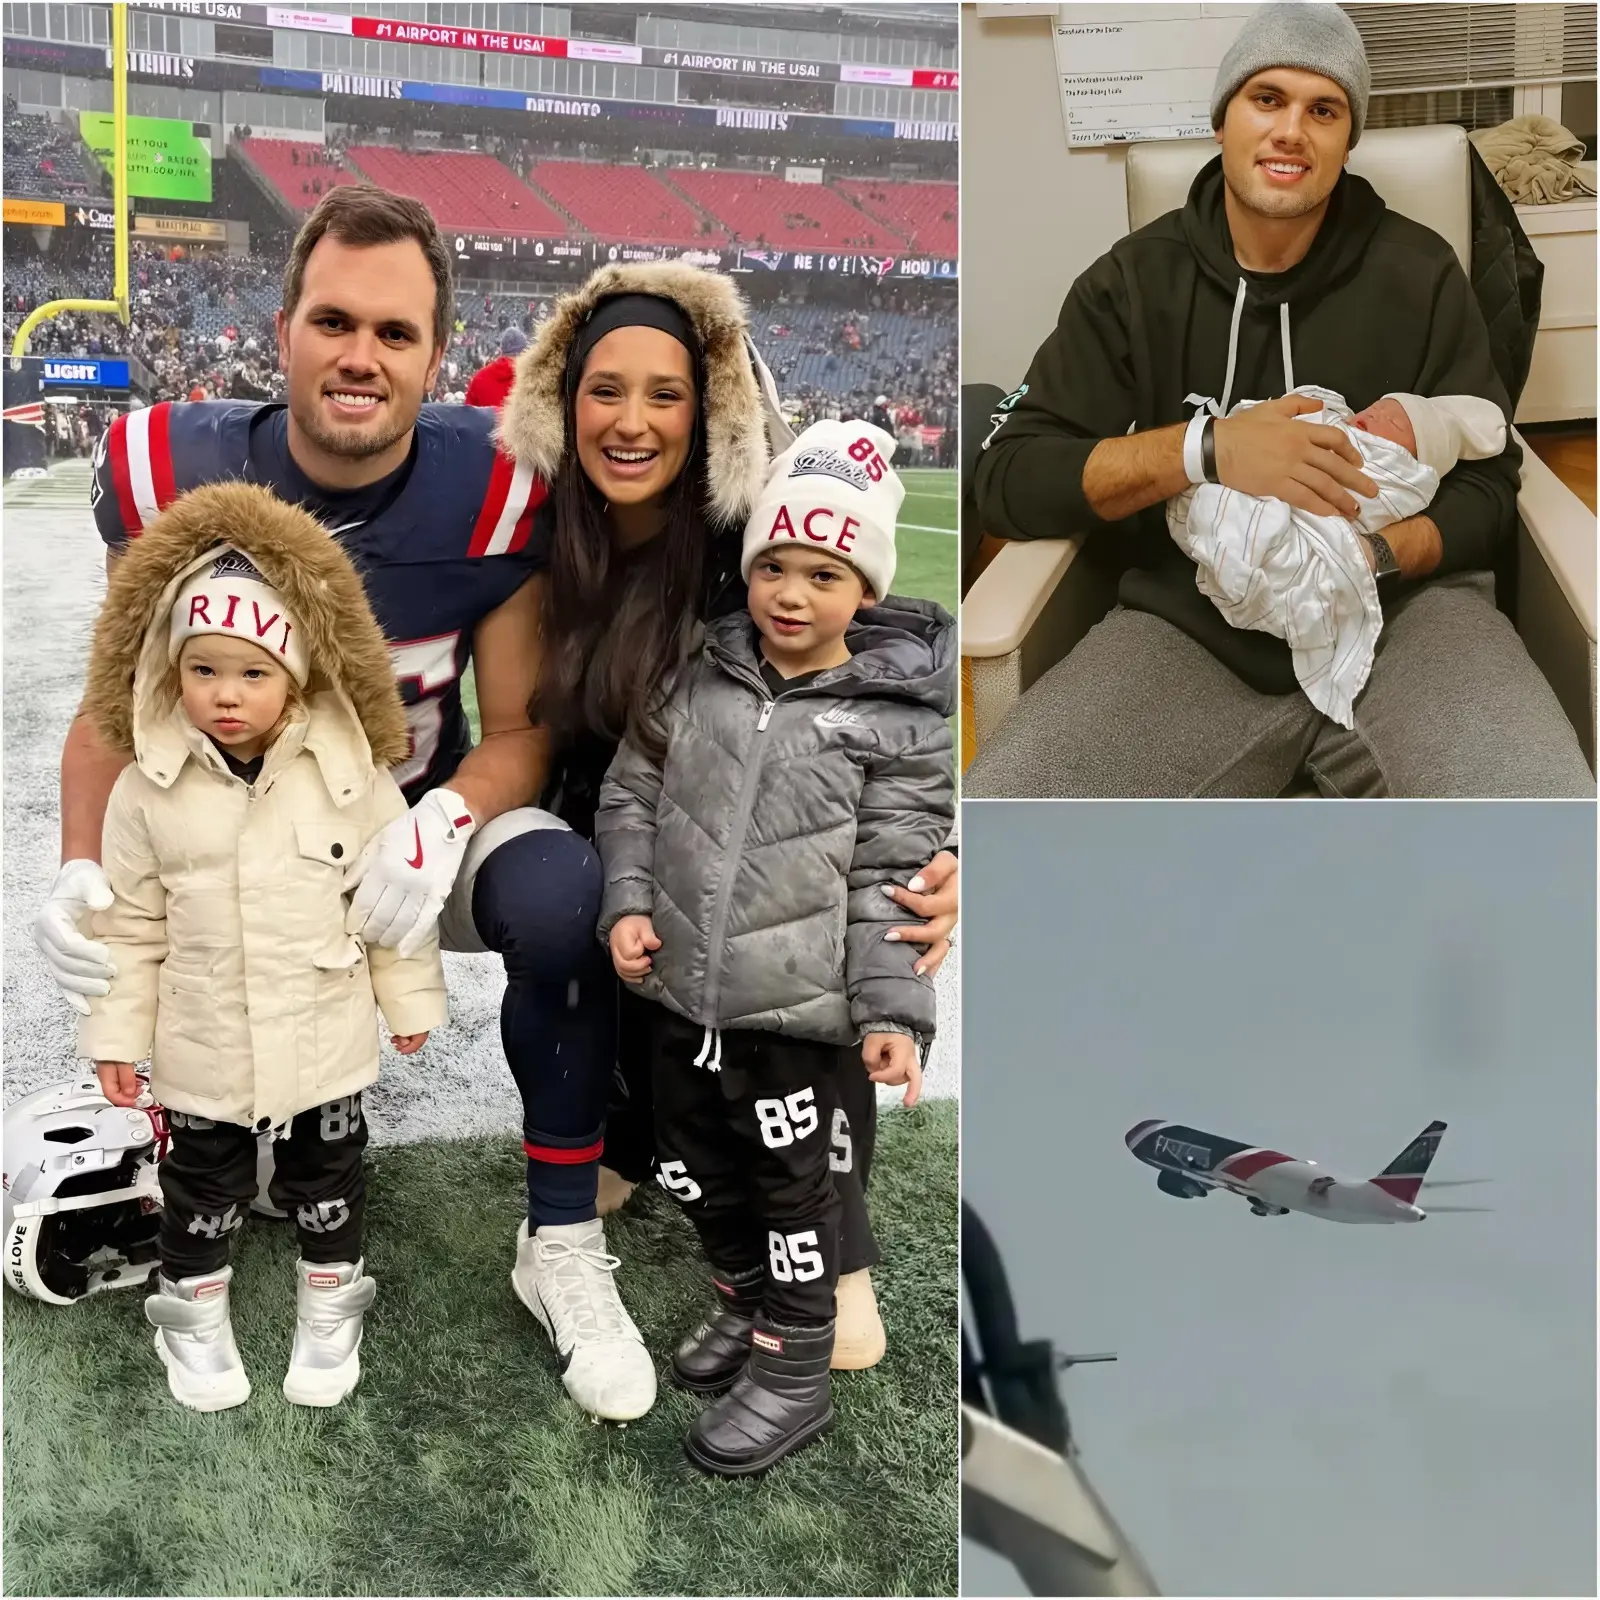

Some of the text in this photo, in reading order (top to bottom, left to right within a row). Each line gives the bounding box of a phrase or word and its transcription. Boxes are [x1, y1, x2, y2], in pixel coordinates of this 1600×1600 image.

[205, 3, 242, 19] USA!
[396, 25, 458, 44] AIRPORT
[462, 32, 477, 45] IN
[482, 34, 508, 49] THE
[513, 38, 545, 53] USA!
[681, 54, 738, 71] AIRPORT
[742, 59, 756, 72] IN
[760, 61, 785, 75] THE
[789, 64, 820, 77] USA!
[321, 72, 402, 99] PATRIOTS
[715, 108, 788, 131] PATRIOTS
[455, 238, 466, 252] 0
[535, 242, 545, 256] 0
[608, 246, 618, 260] 0
[794, 255, 813, 270] NE
[901, 259, 930, 275] HOU
[44, 363, 97, 380] LIGHT
[848, 437, 888, 482] 85
[768, 505, 861, 553] ACE
[188, 594, 292, 655] RIVI
[756, 1087, 819, 1149] 85
[297, 1197, 350, 1234] 85
[11, 1225, 28, 1267] LOVE
[768, 1230, 825, 1283] 85
